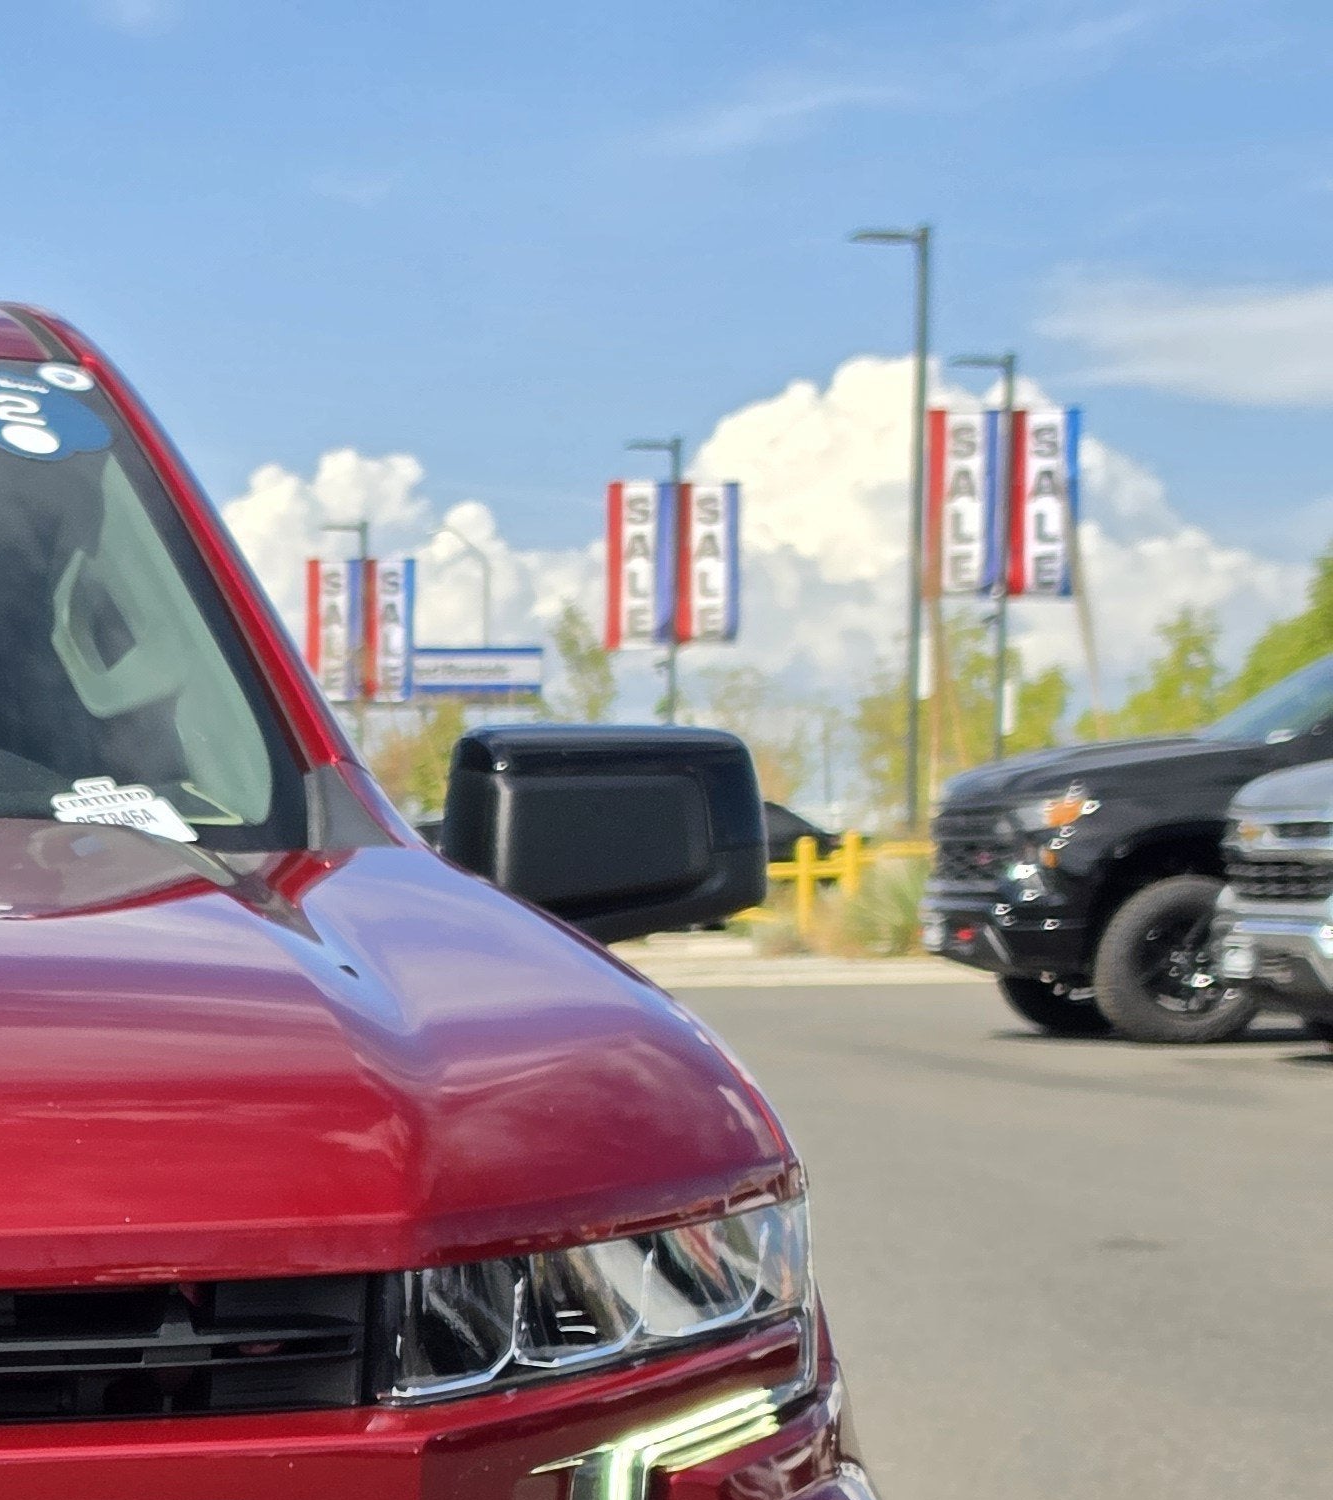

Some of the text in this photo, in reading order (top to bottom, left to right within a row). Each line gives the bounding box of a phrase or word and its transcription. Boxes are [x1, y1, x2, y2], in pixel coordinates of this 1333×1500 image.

[626, 496, 651, 638] SALE
[694, 496, 721, 638] SALE
[949, 422, 978, 586] SALE
[1031, 422, 1060, 588] SALE
[323, 570, 343, 692] SALE
[381, 570, 401, 692] SALE
[57, 791, 149, 809] CERTIFIED
